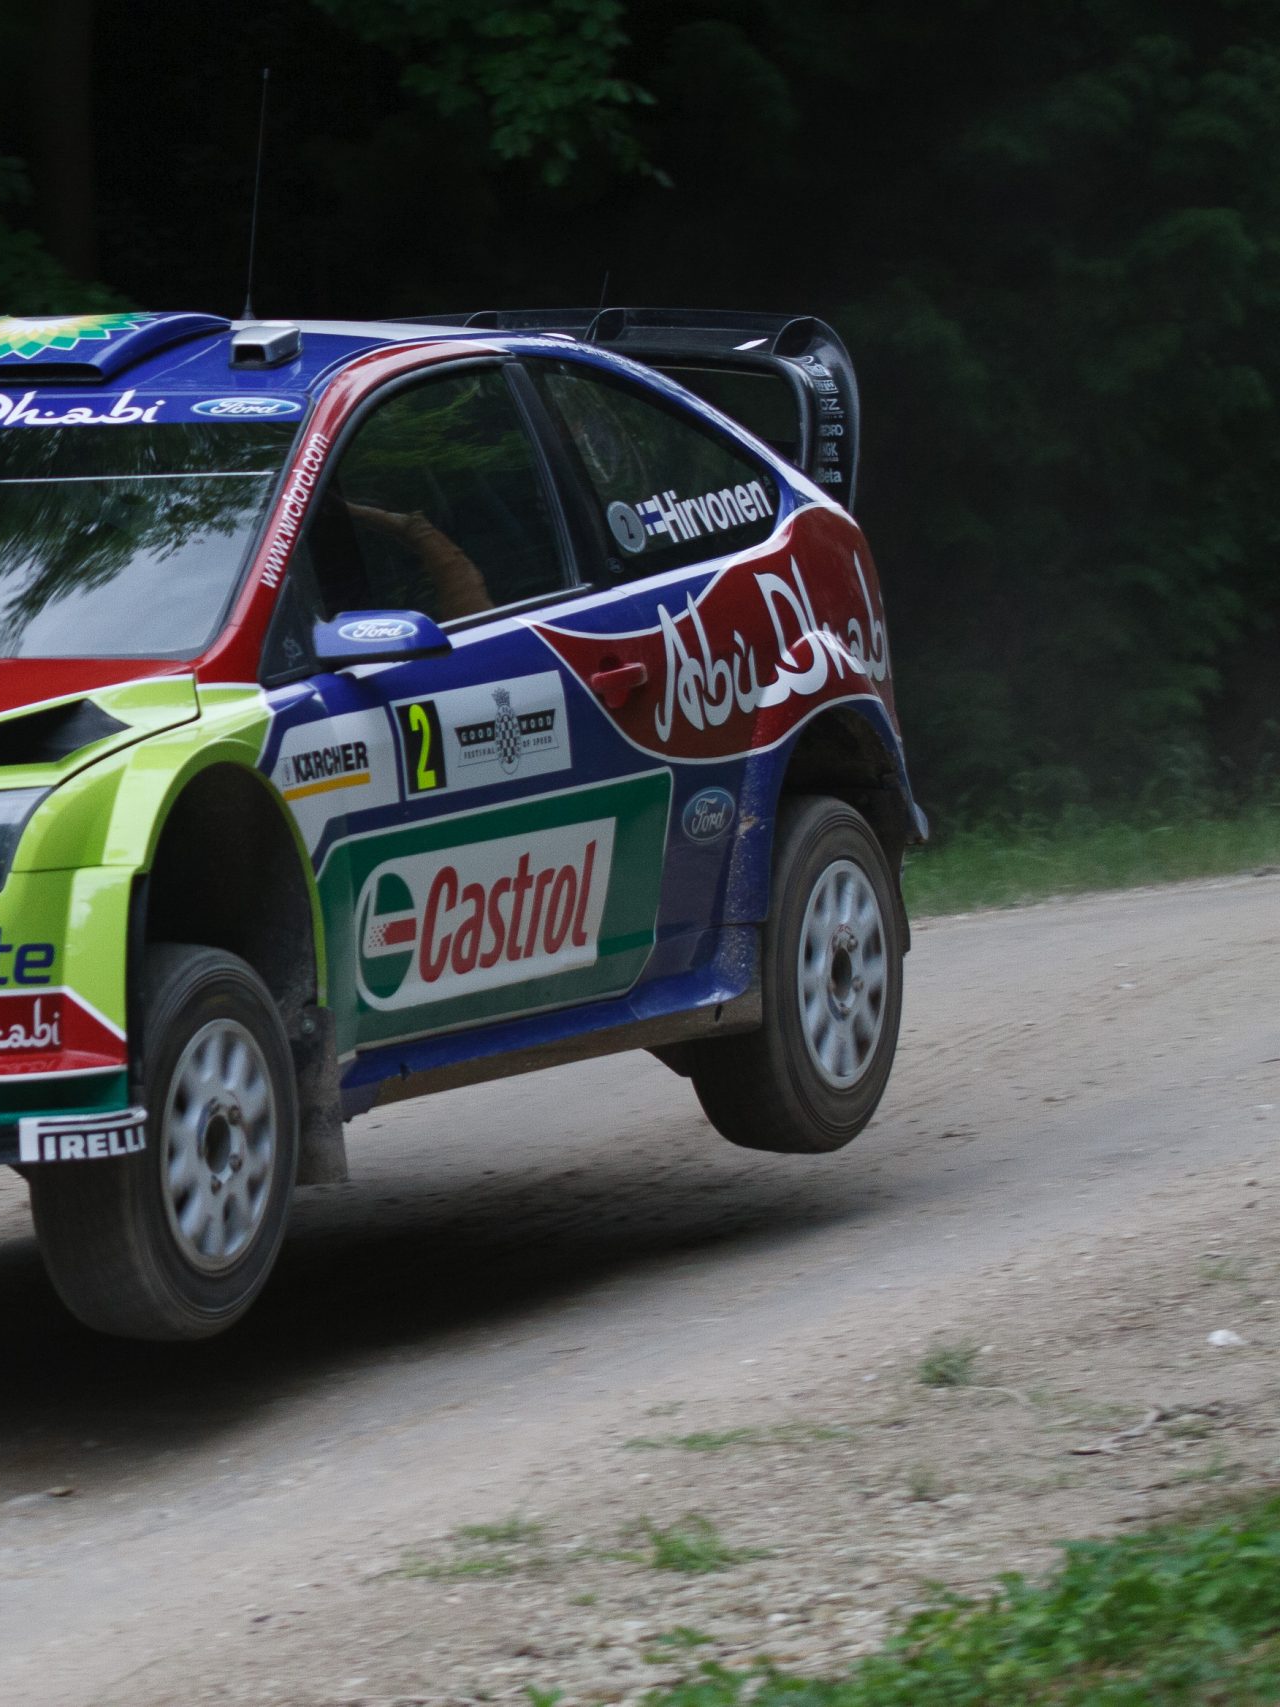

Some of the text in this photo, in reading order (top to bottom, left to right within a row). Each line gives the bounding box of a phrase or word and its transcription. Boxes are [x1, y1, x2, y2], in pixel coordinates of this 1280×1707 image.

[261, 433, 330, 588] www.wrcford.com
[652, 480, 773, 543] Hirvonen
[409, 704, 436, 790] 2
[690, 800, 726, 834] Ford
[420, 840, 597, 984] Castrol
[20, 1107, 147, 1163] PIRELLI
